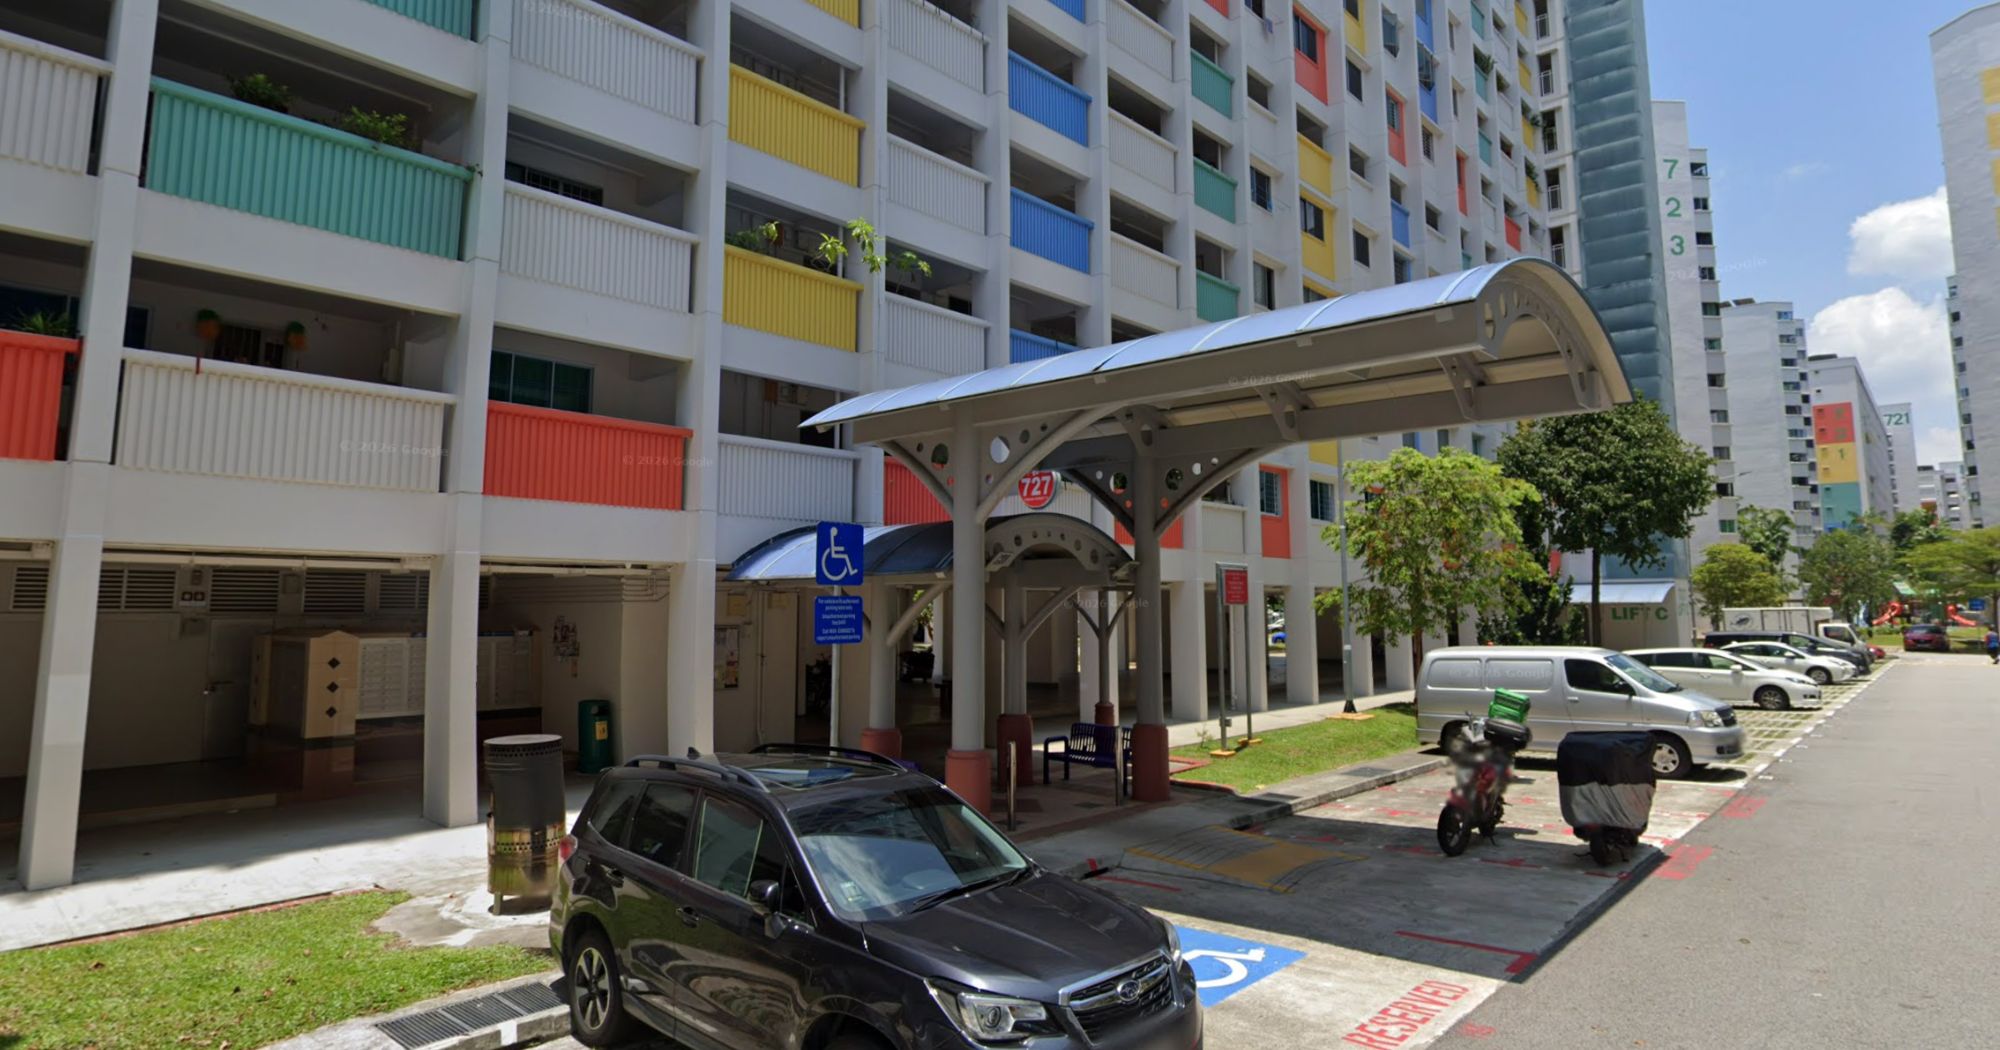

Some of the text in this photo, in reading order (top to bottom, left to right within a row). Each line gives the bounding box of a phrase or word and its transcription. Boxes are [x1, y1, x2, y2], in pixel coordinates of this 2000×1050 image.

[1883, 412, 1911, 427] 721
[1021, 475, 1052, 498] 727
[1655, 607, 1669, 621] C
[1341, 979, 1470, 1050] RESERVED
